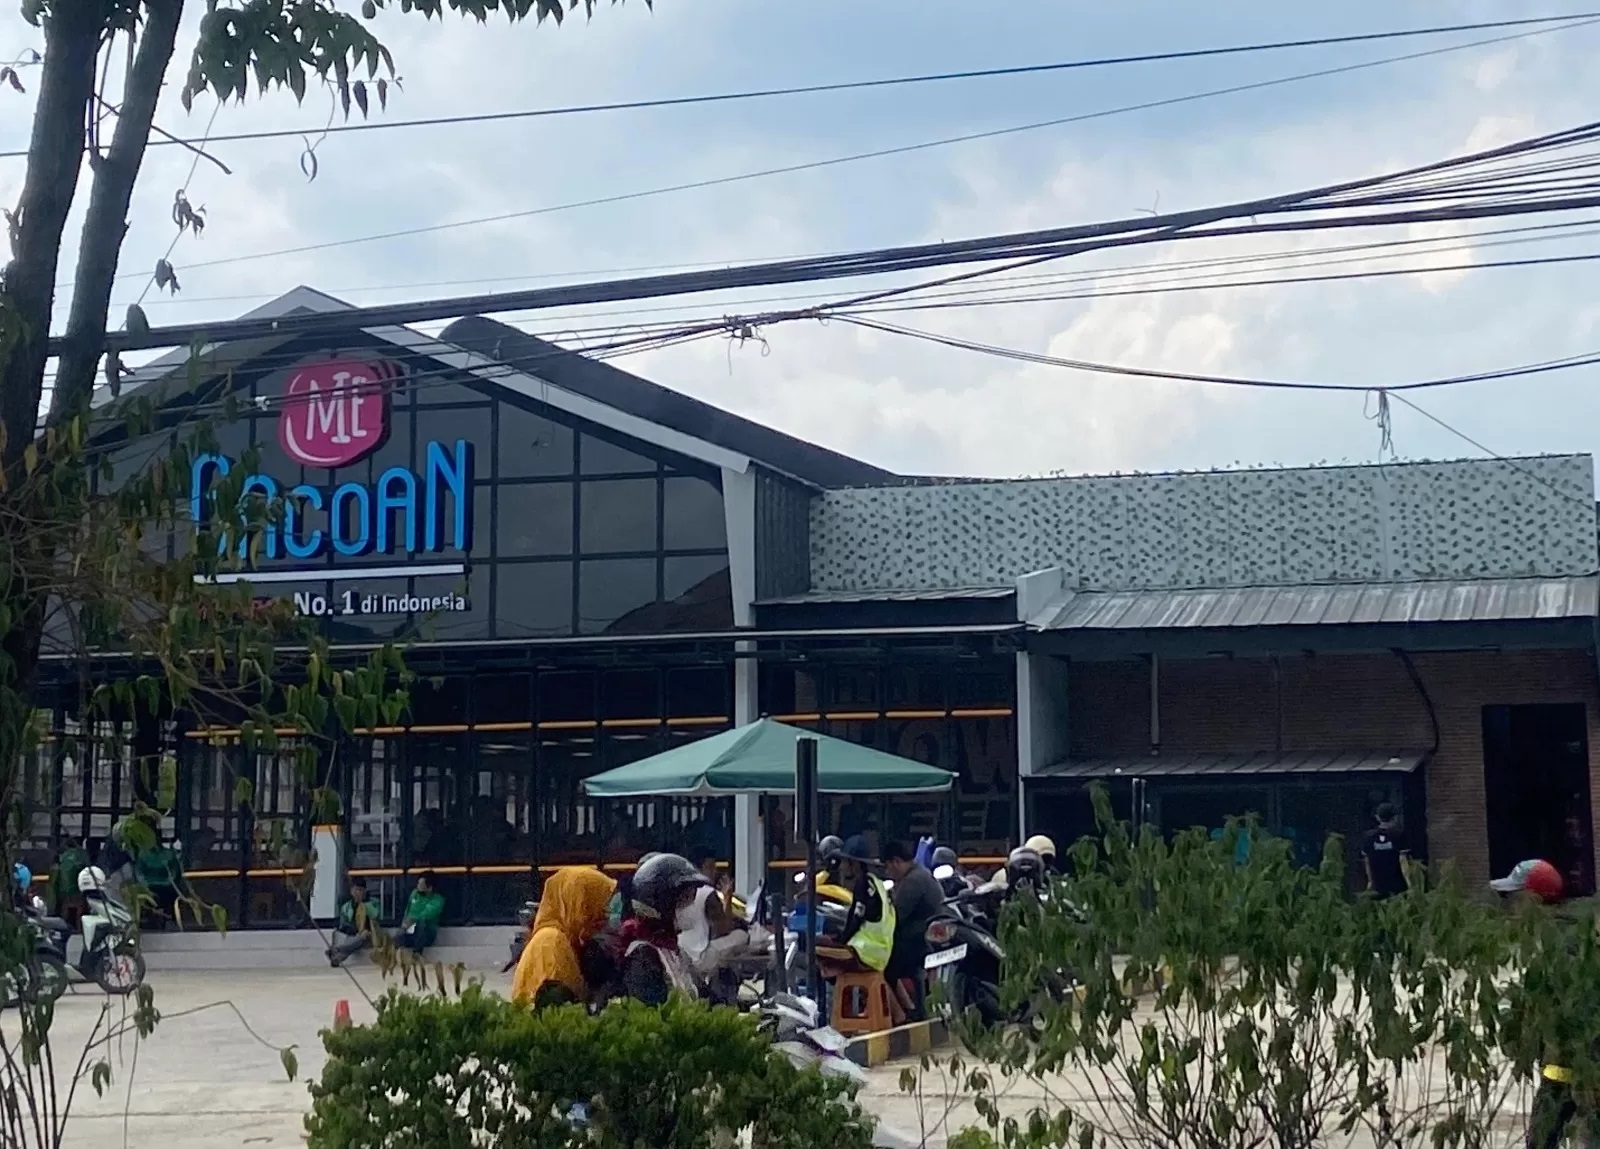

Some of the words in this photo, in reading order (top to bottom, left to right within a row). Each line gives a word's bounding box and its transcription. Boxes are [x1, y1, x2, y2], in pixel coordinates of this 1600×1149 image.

[306, 371, 368, 443] MIE
[293, 591, 334, 616] No.
[341, 590, 355, 615] 1
[360, 594, 377, 614] di
[382, 591, 465, 613] Indonesia
